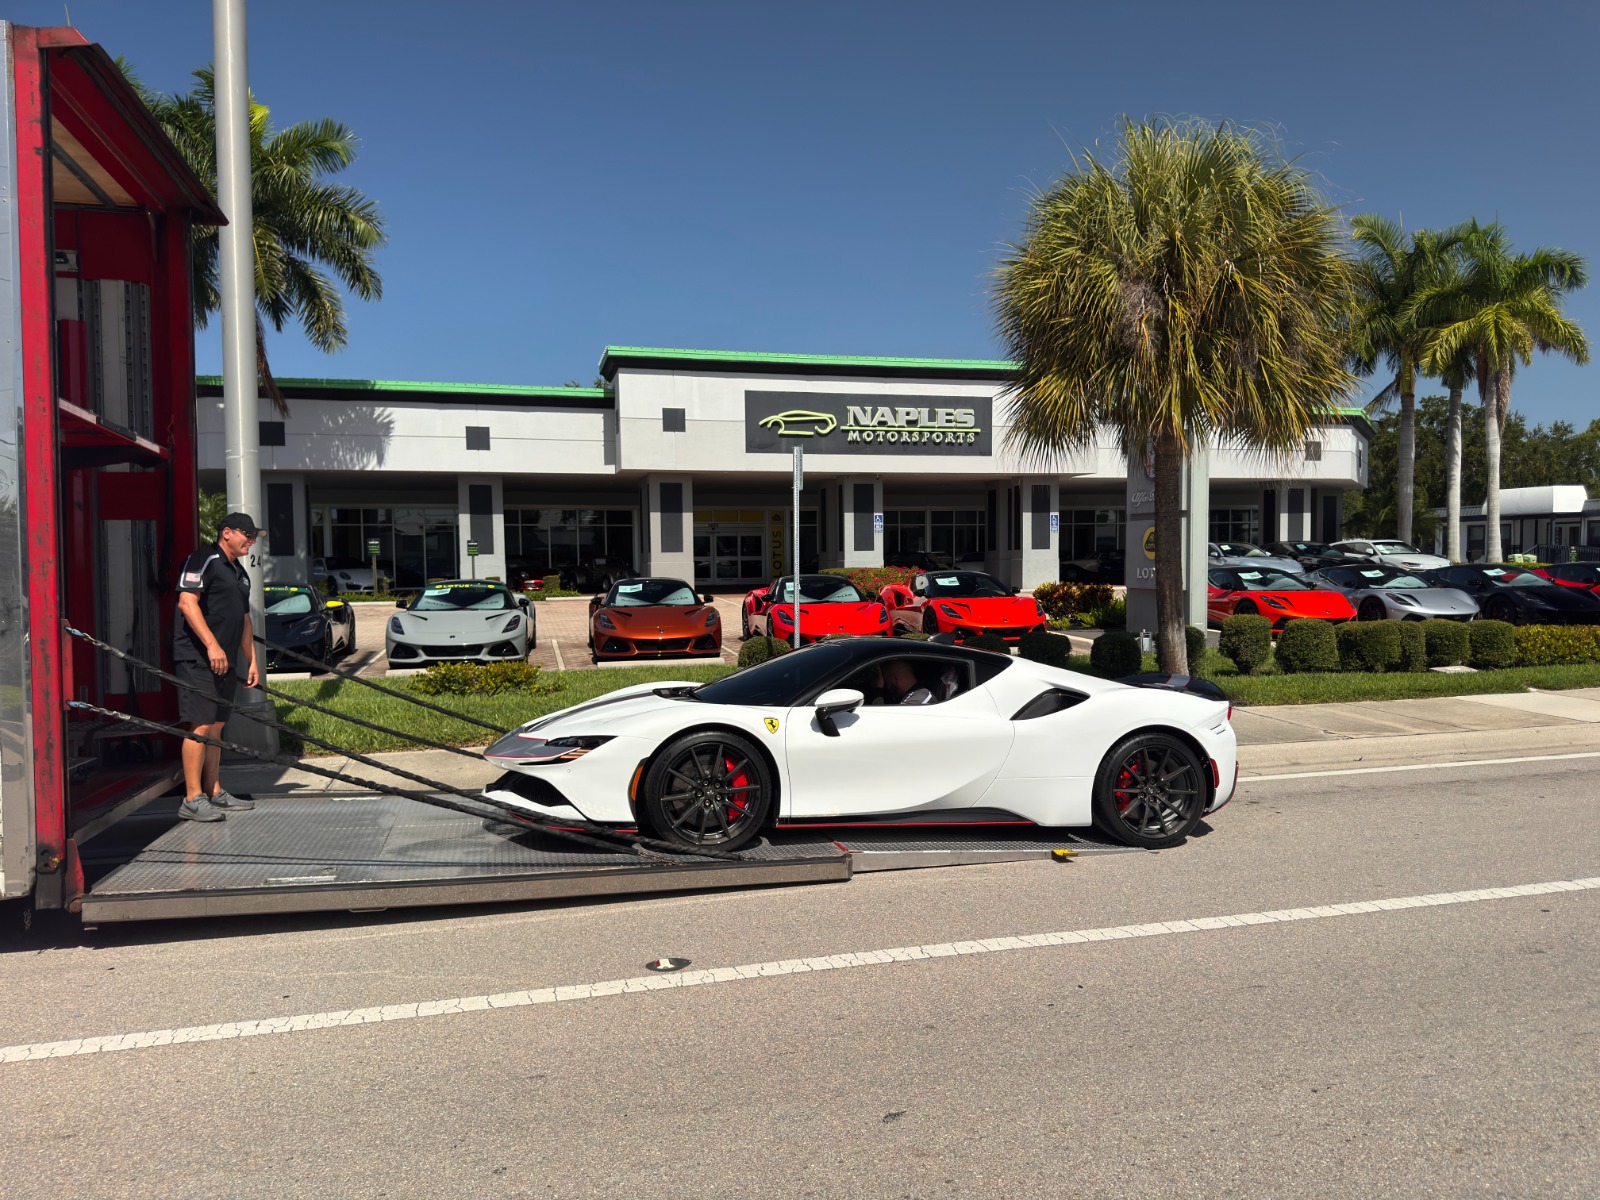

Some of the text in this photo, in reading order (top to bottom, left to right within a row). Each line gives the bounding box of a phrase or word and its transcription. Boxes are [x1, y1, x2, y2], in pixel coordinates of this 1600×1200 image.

[847, 405, 975, 428] NAPLES
[847, 430, 975, 444] MOTORSPORTS
[250, 554, 261, 568] 24
[1136, 567, 1155, 579] LOT
